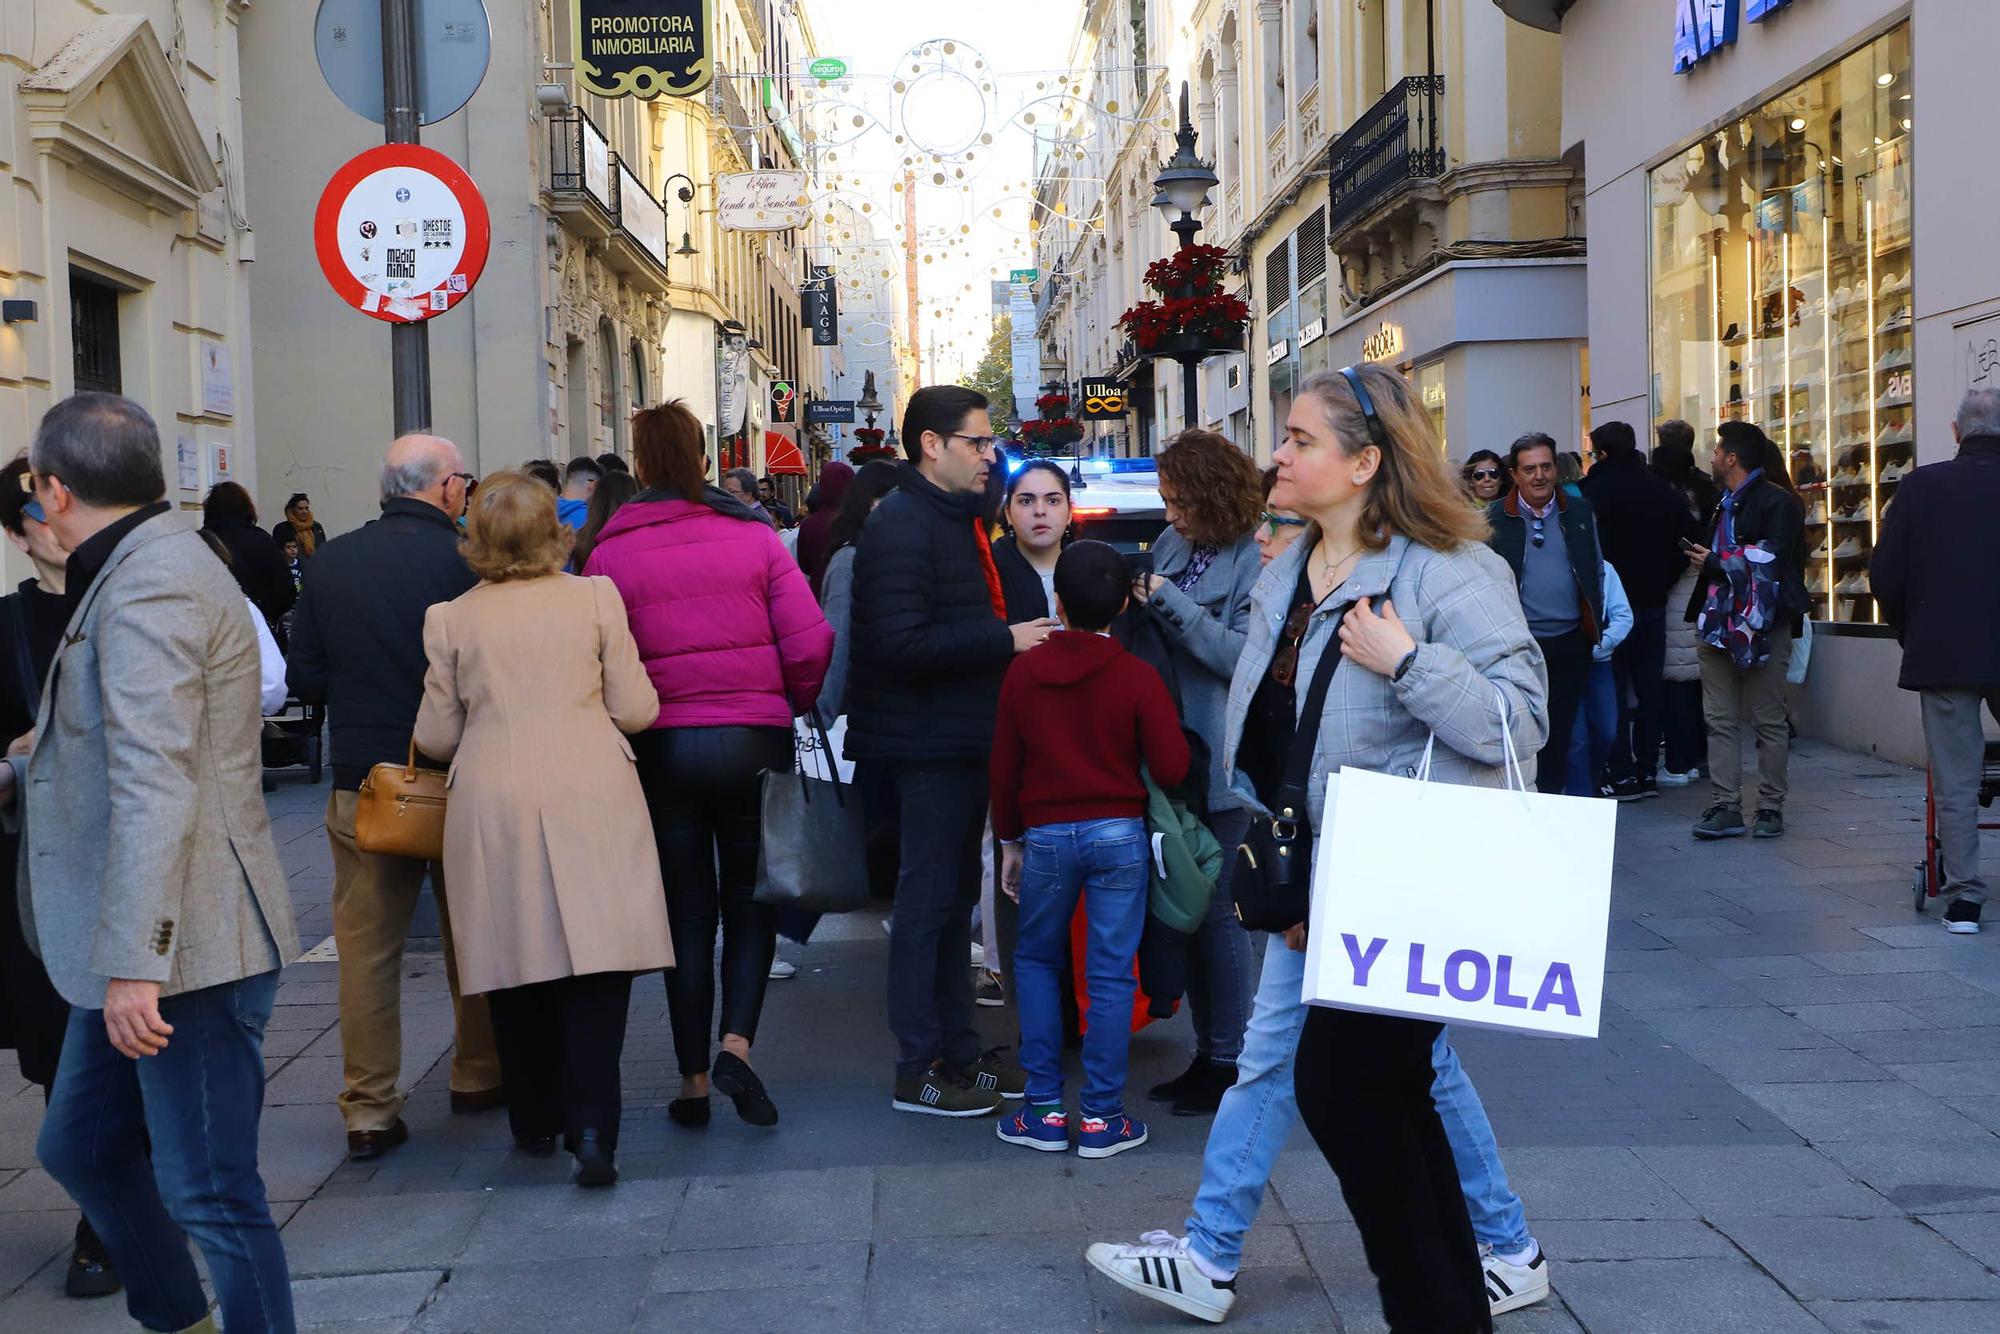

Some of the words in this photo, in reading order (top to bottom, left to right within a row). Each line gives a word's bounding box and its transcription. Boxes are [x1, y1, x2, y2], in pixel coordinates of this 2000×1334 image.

[591, 16, 694, 34] PROMOTORA
[592, 36, 695, 55] INMOBILIARIA
[819, 268, 830, 328] SNAG
[1085, 384, 1121, 397] Ulloa
[1340, 933, 1388, 987] Y
[1406, 942, 1582, 1017] LOLA
